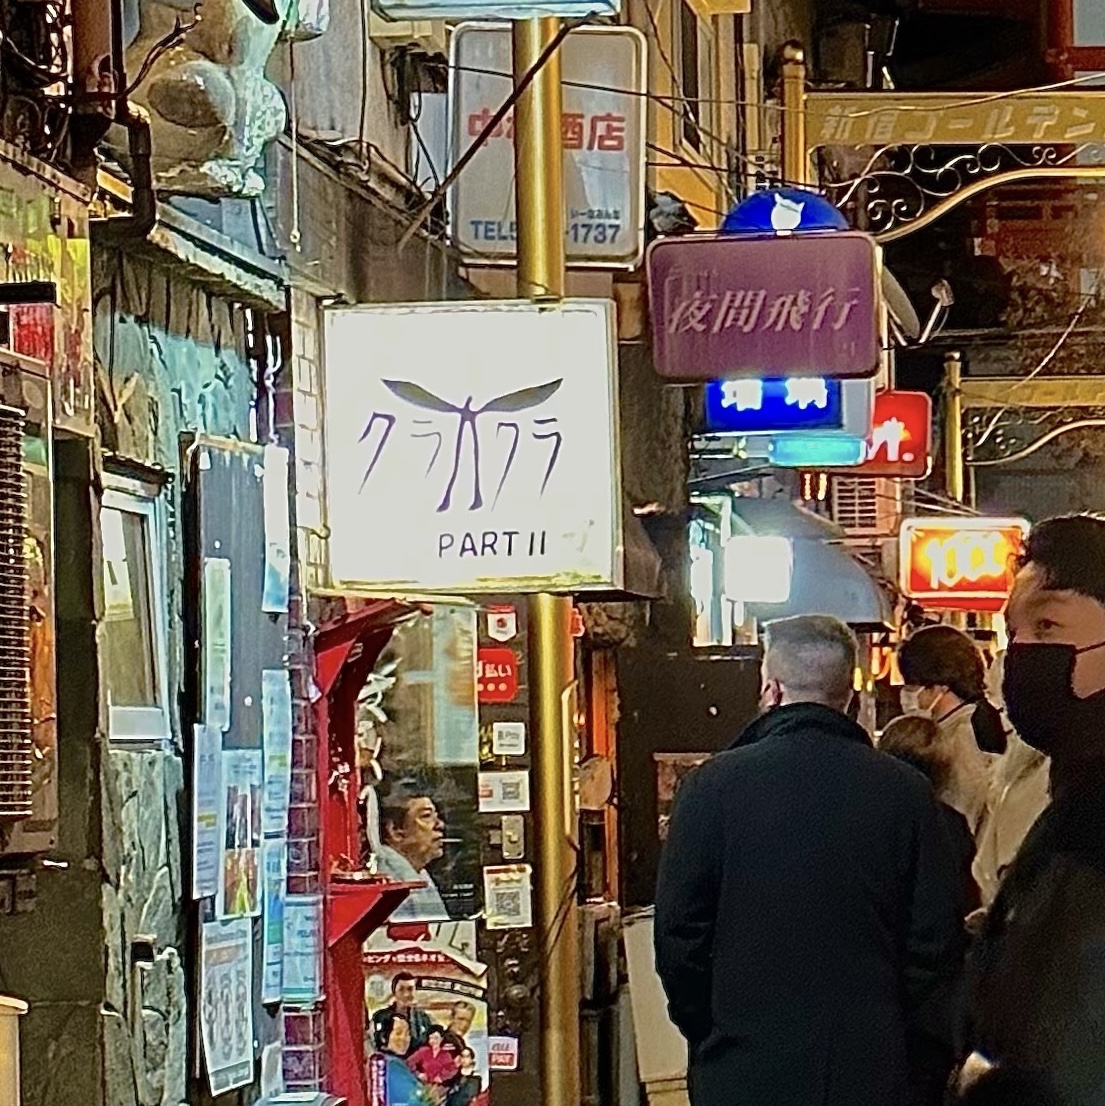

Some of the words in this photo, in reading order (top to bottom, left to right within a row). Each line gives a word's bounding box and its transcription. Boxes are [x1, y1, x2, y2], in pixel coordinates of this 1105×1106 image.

[468, 108, 626, 152] 中酒店
[668, 287, 861, 333] 夜間飛行
[438, 530, 519, 557] PART
